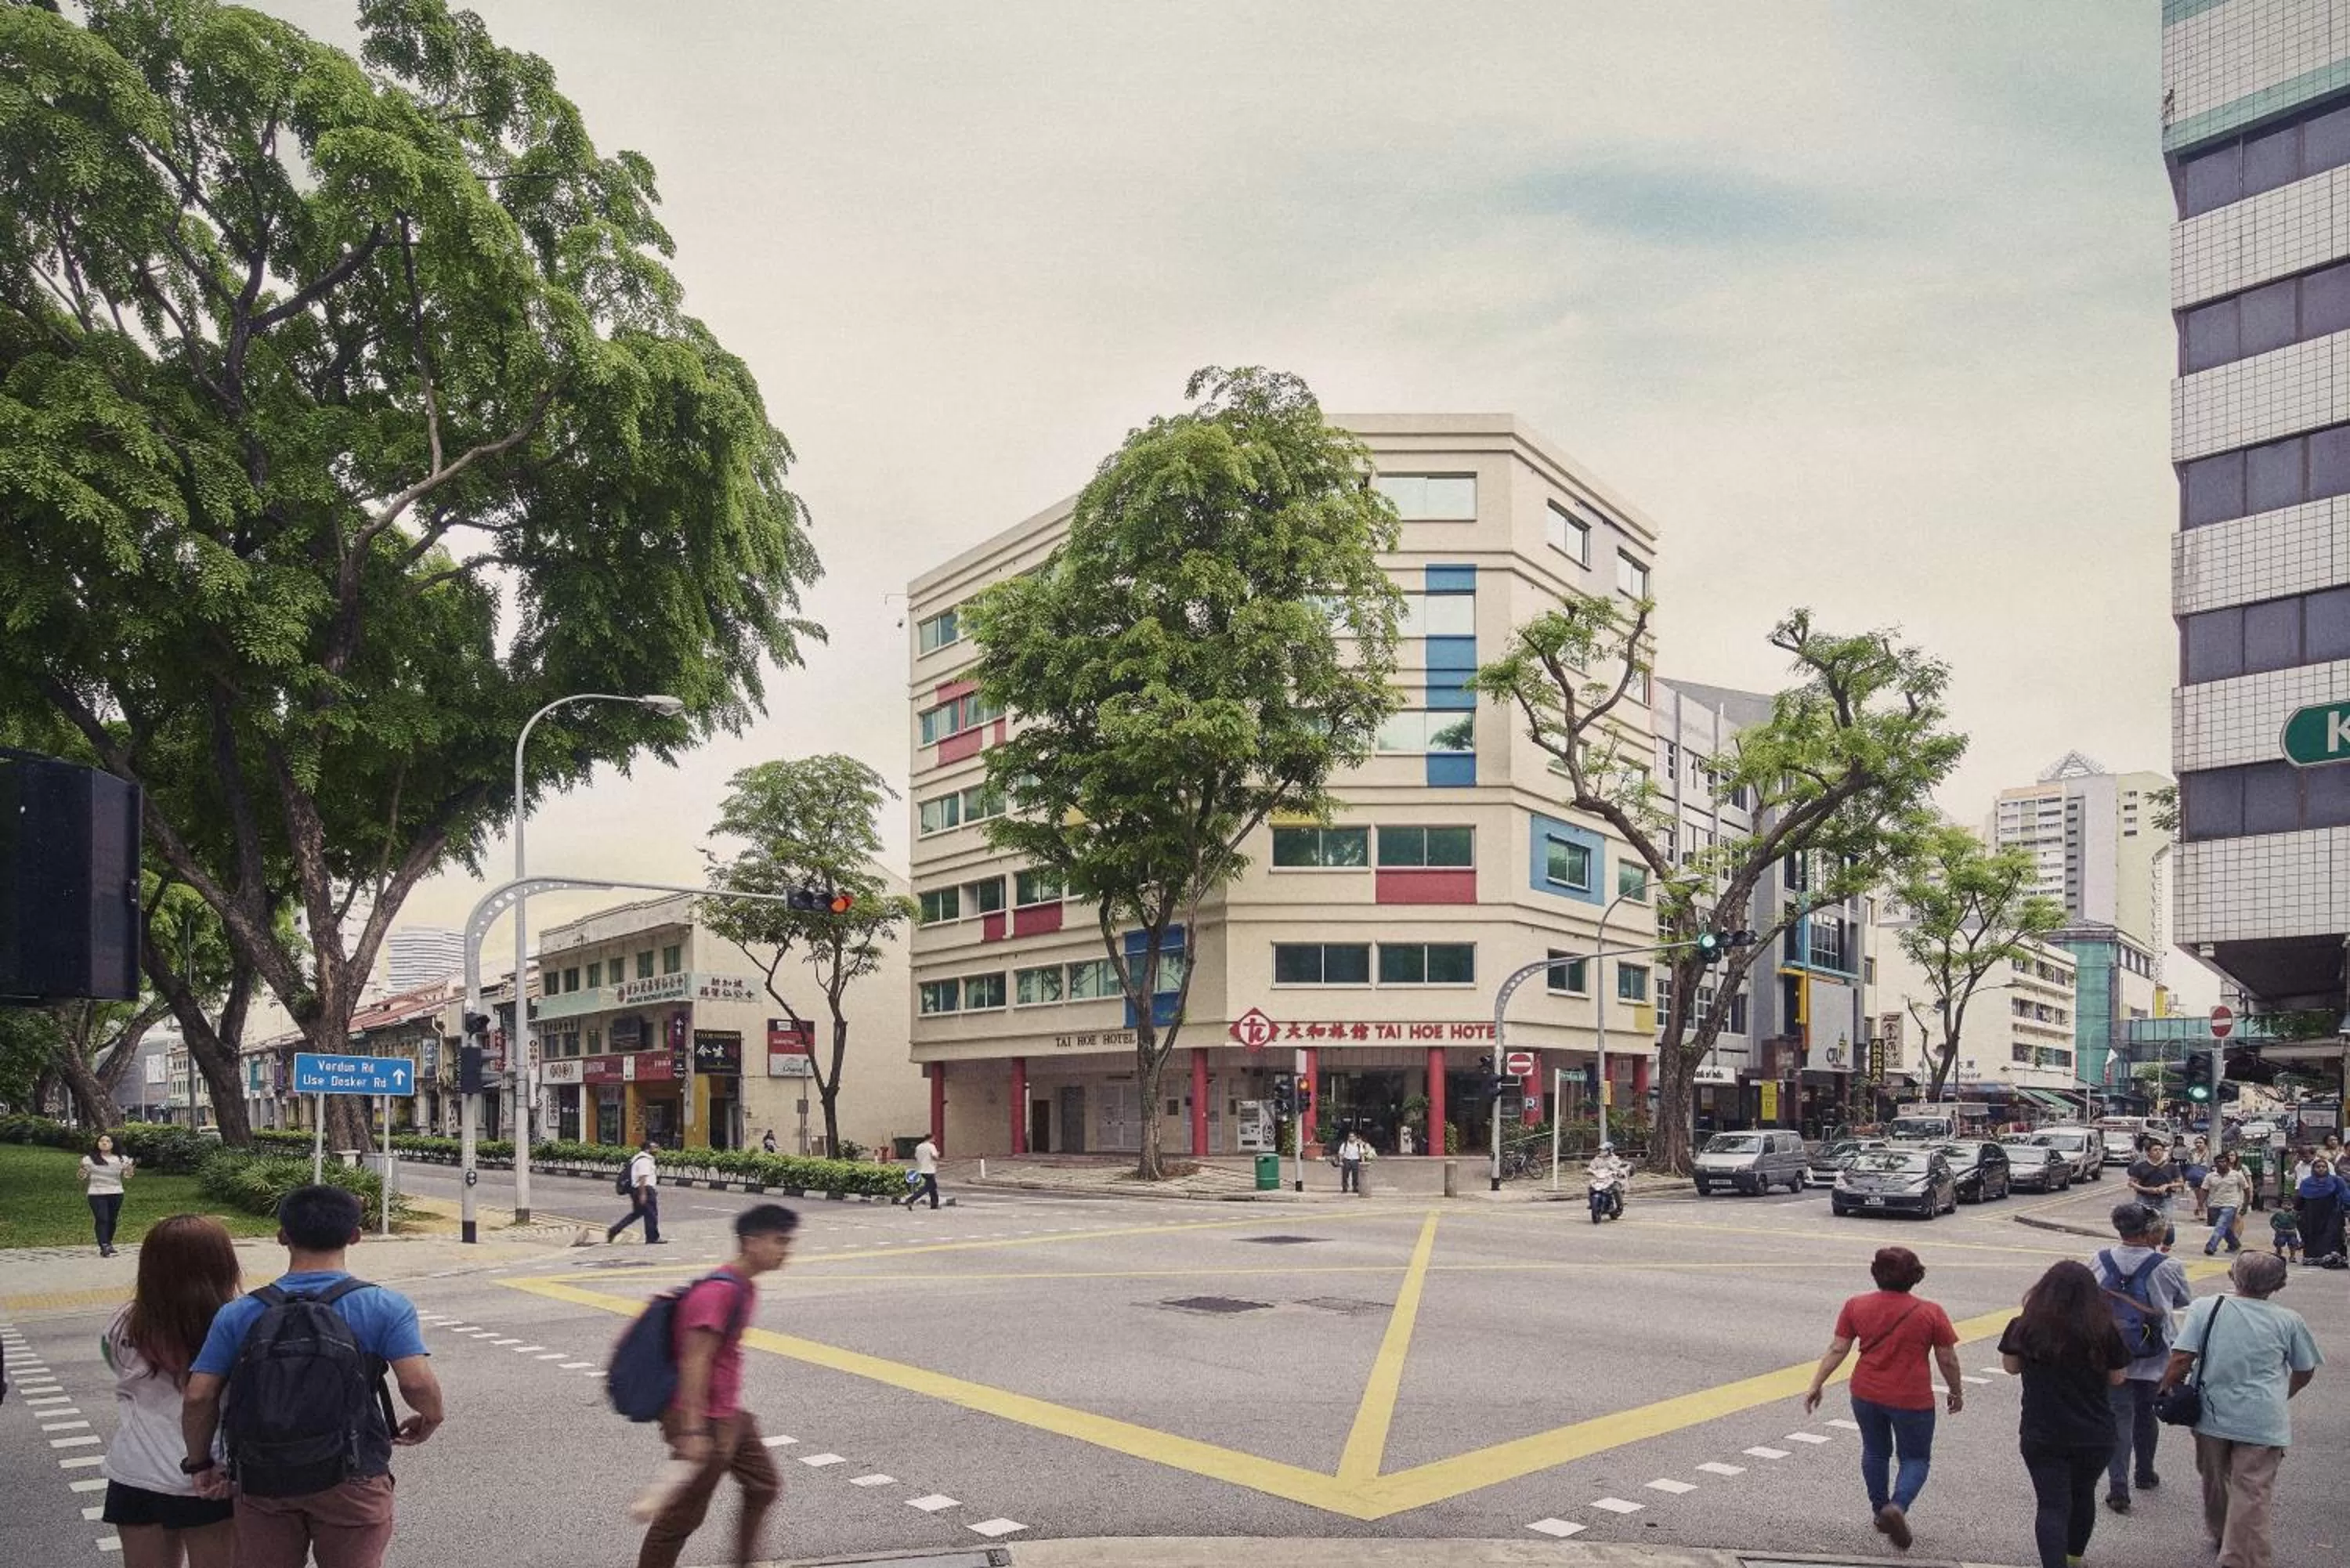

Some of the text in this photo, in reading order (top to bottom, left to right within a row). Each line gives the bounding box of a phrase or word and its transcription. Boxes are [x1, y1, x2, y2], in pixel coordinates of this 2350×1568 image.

[1376, 1024, 1505, 1039] TAI HOE HOTE
[1055, 1033, 1136, 1047] TAI HOE HOTEL
[318, 1060, 374, 1073] Verdun Rd
[303, 1075, 386, 1088] Use Desker Rd
